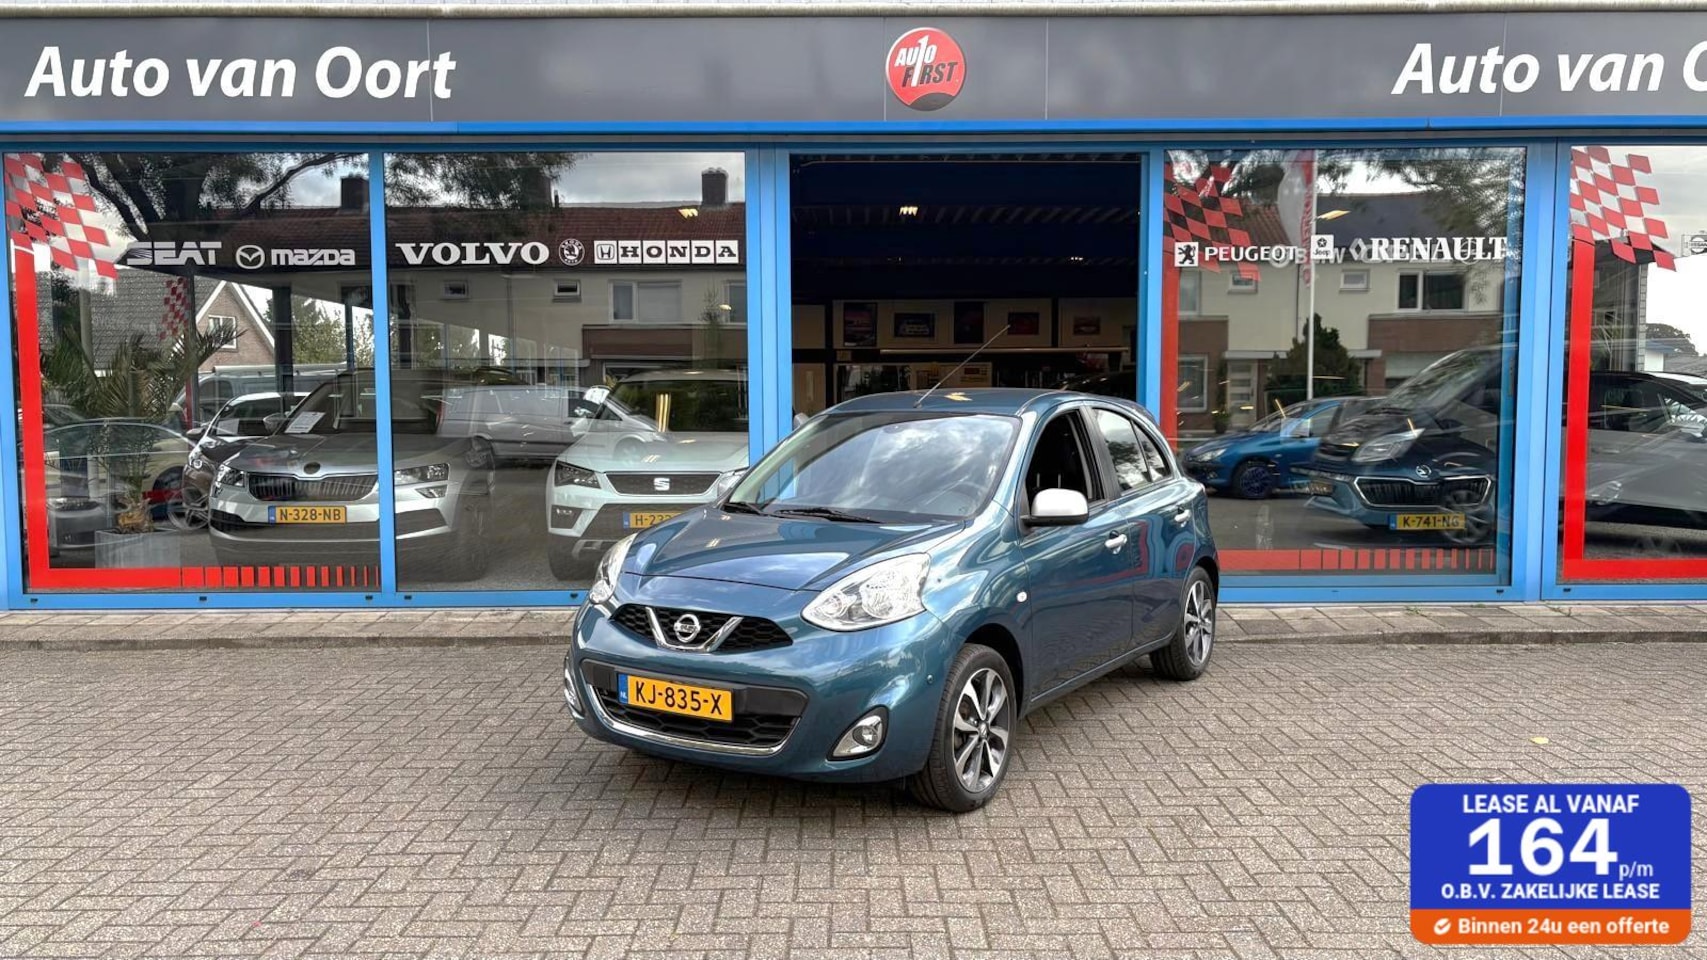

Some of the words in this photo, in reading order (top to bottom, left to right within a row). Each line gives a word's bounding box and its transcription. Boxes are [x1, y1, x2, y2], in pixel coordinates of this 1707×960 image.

[24, 46, 169, 97] Auto
[186, 58, 297, 97] van
[314, 46, 457, 98] Oort
[1391, 43, 1540, 95] Auto
[1557, 53, 1665, 92] van
[126, 241, 222, 266] SEAT
[395, 241, 550, 265] VOLVO
[619, 242, 739, 262] HONDA
[1204, 245, 1298, 262] PEUGEOT
[1370, 236, 1508, 261] RENAULT
[280, 508, 341, 521] N-328-NB
[635, 680, 722, 715] KJ-835-X
